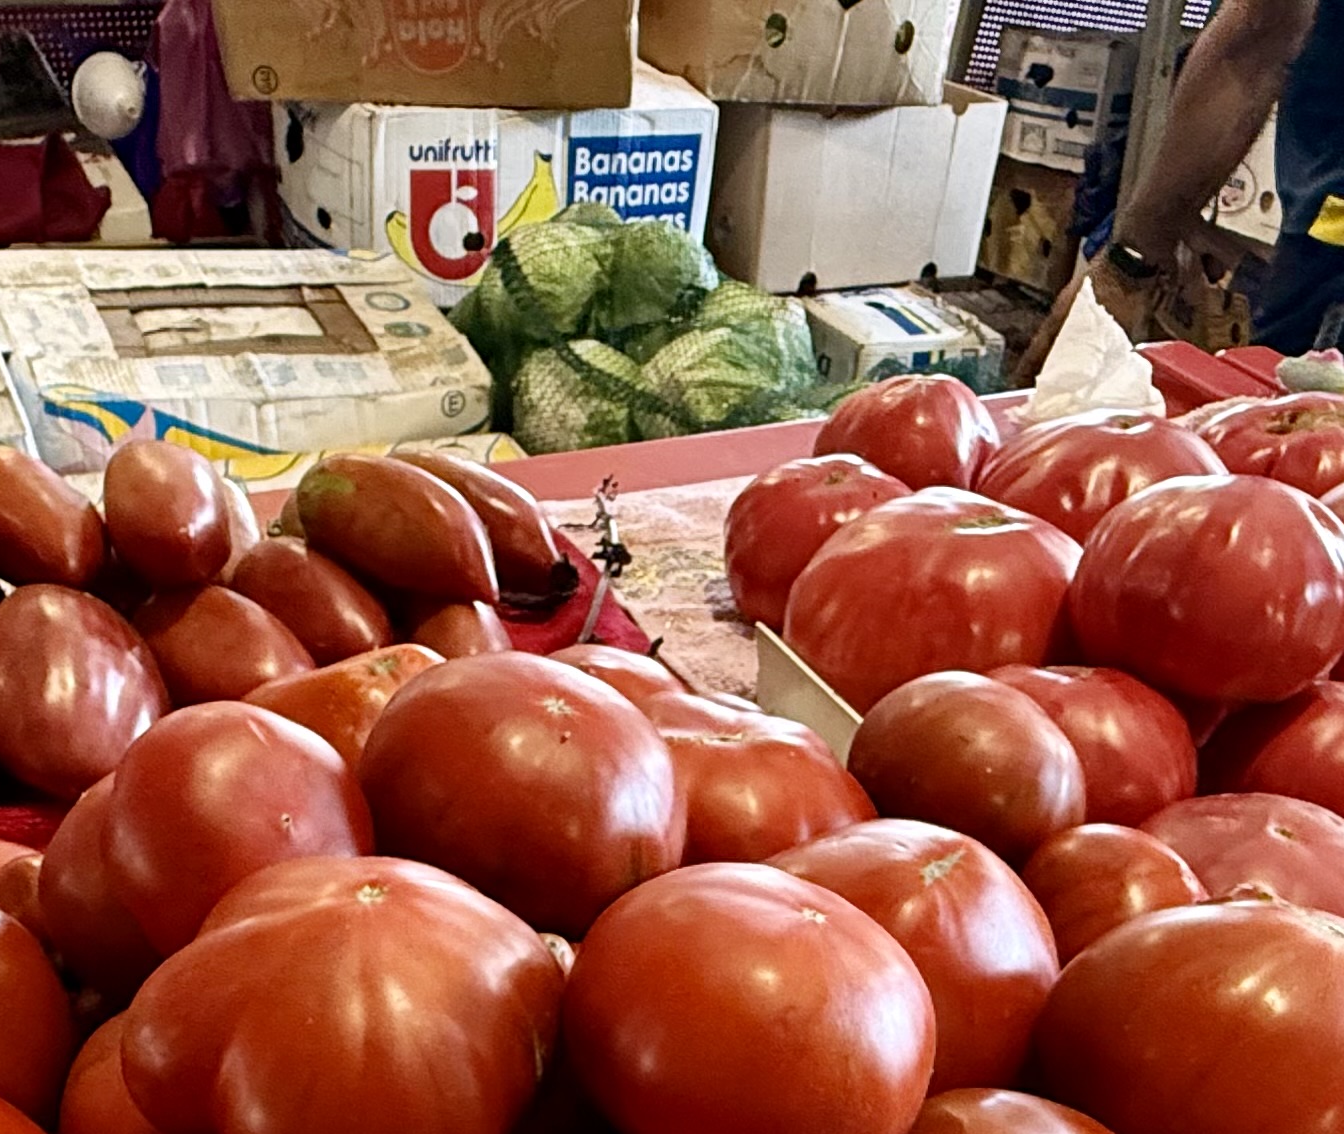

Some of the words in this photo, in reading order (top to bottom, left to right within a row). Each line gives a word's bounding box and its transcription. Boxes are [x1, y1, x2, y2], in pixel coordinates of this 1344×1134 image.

[408, 138, 497, 163] unifrutti
[575, 147, 693, 176] Bananas
[573, 180, 690, 208] Bananas
